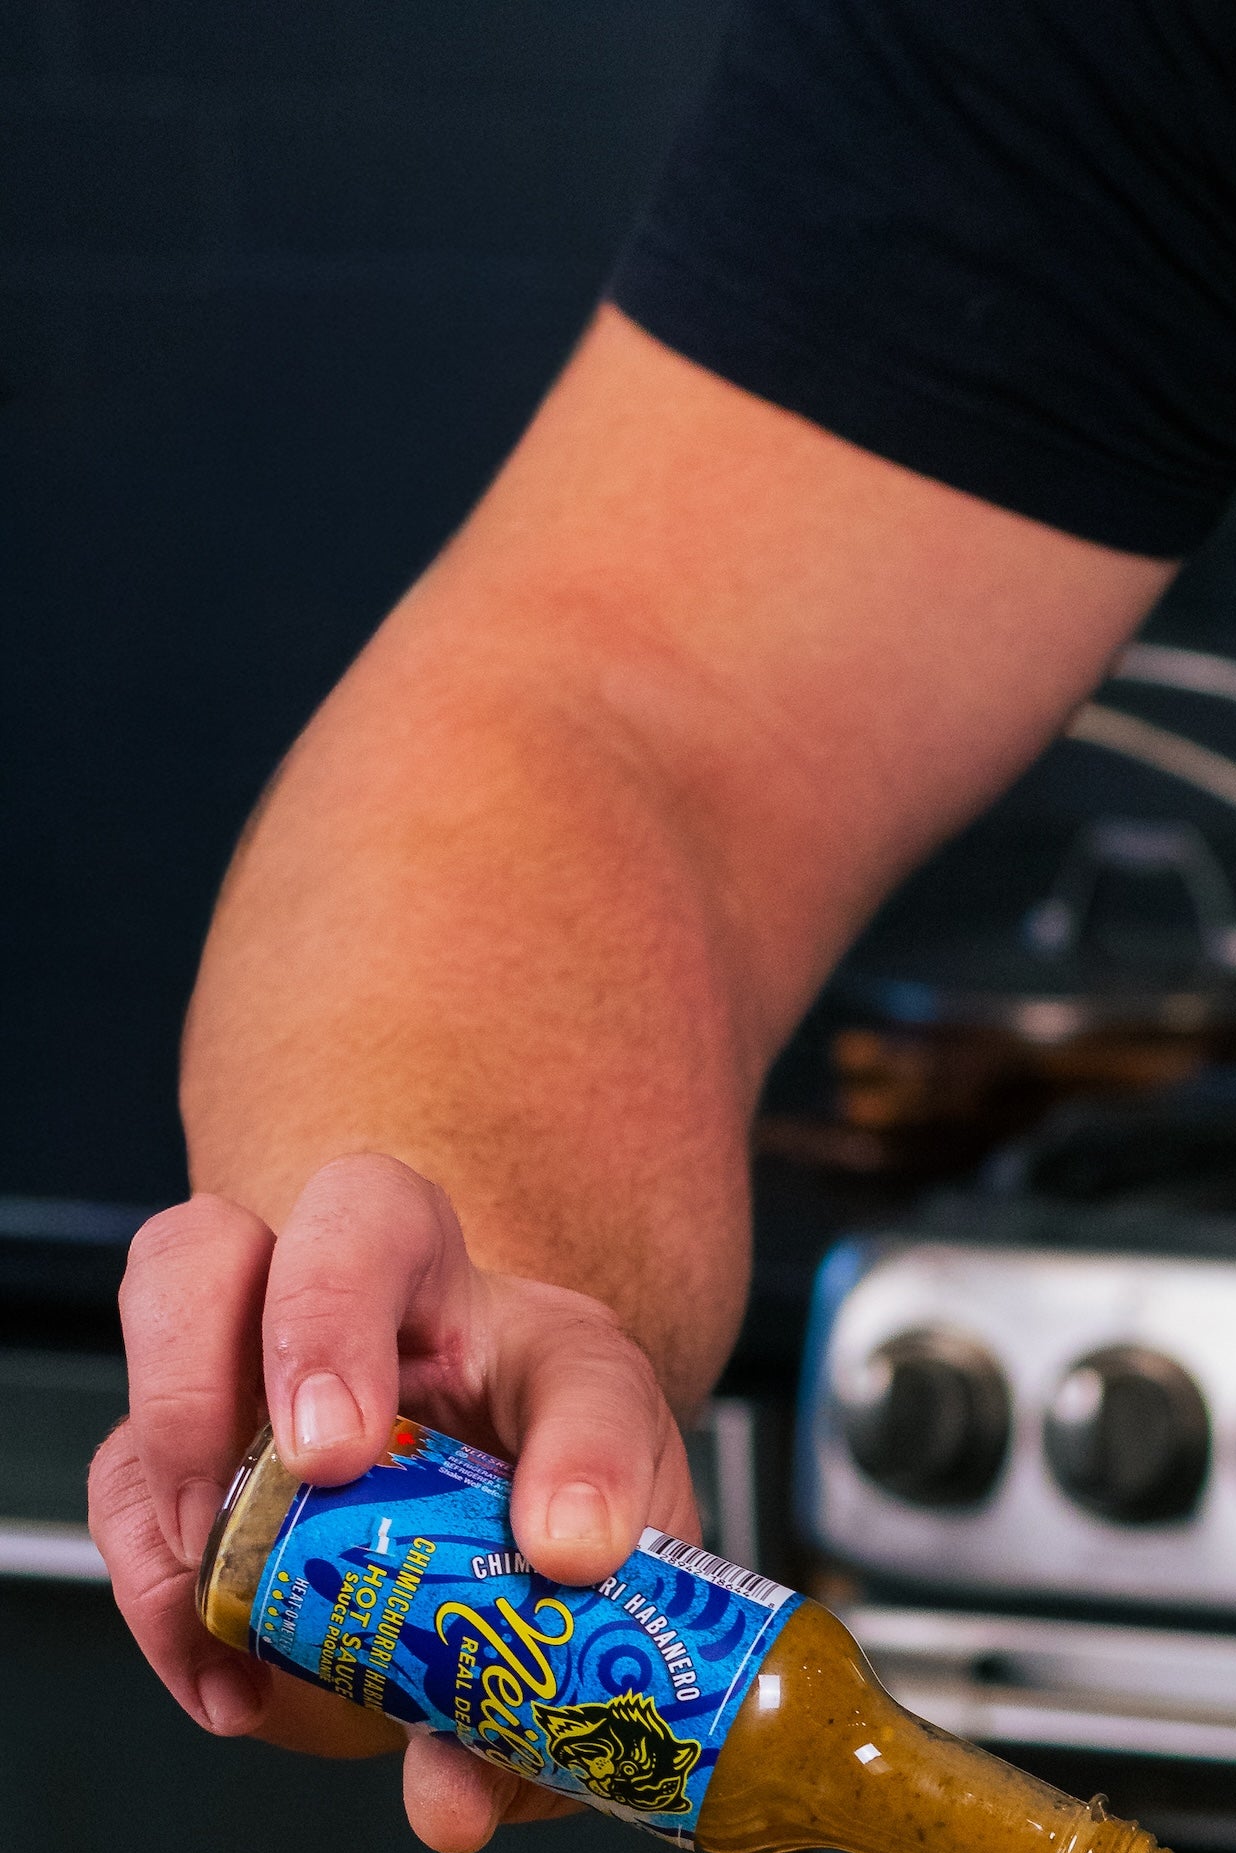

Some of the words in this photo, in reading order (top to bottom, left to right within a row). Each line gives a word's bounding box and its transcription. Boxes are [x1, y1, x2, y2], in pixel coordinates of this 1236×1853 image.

[438, 1466, 463, 1482] Shake
[463, 1477, 482, 1489] Well
[330, 1572, 359, 1625] SAUCE
[350, 1564, 387, 1628] HOT
[368, 1536, 436, 1669] CHIMICHURRI
[659, 1553, 703, 1576] 28942
[710, 1576, 750, 1598] 18644
[279, 1577, 309, 1652] HEAT-O-METER
[623, 1592, 700, 1701] HABANERO
[334, 1632, 362, 1699] SAUCE
[454, 1635, 479, 1690] REAL
